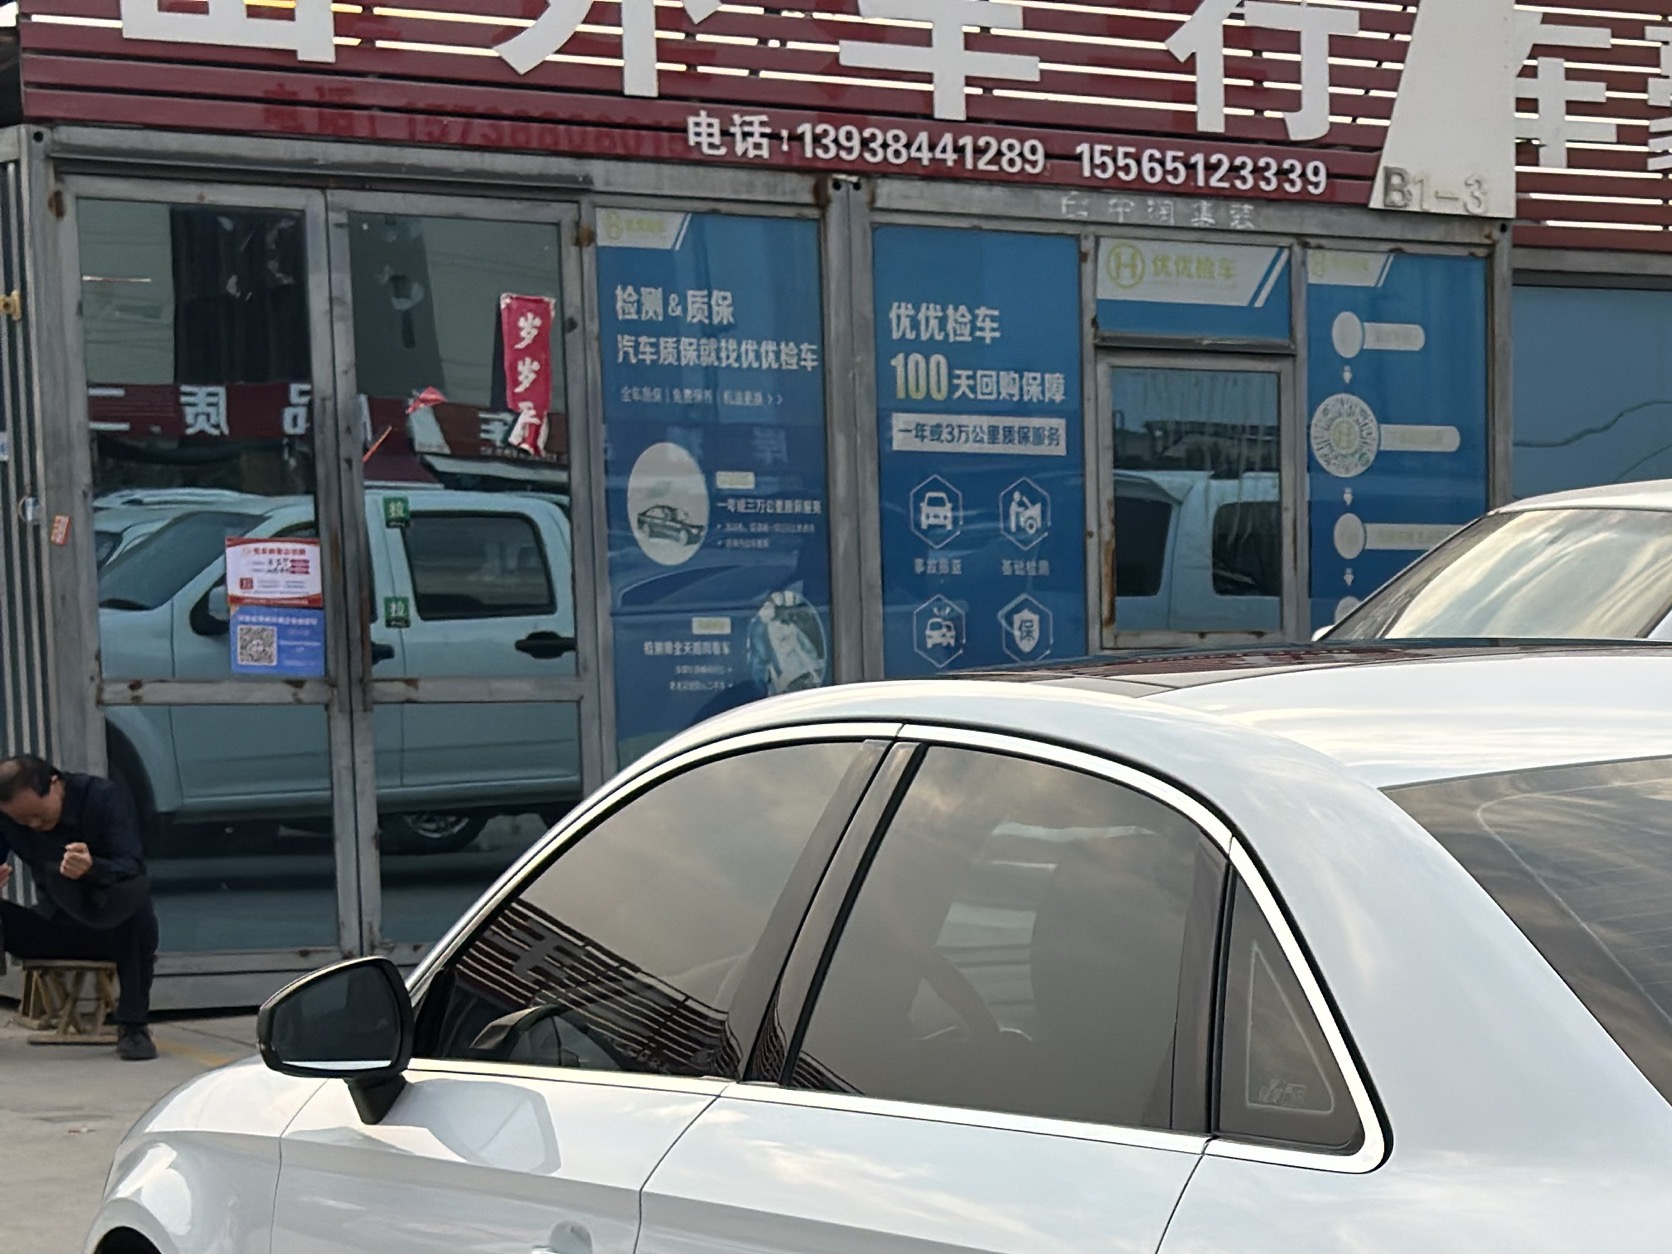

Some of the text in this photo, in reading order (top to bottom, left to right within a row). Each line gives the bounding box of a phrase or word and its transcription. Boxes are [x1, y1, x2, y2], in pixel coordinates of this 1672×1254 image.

[1075, 142, 1328, 195] 15565123339
[889, 302, 1001, 344] 优优检车
[617, 334, 819, 371] 汽车质保就找优优检车
[897, 422, 1061, 447] 一年或3万公里质保服务
[1019, 619, 1036, 642] 保
